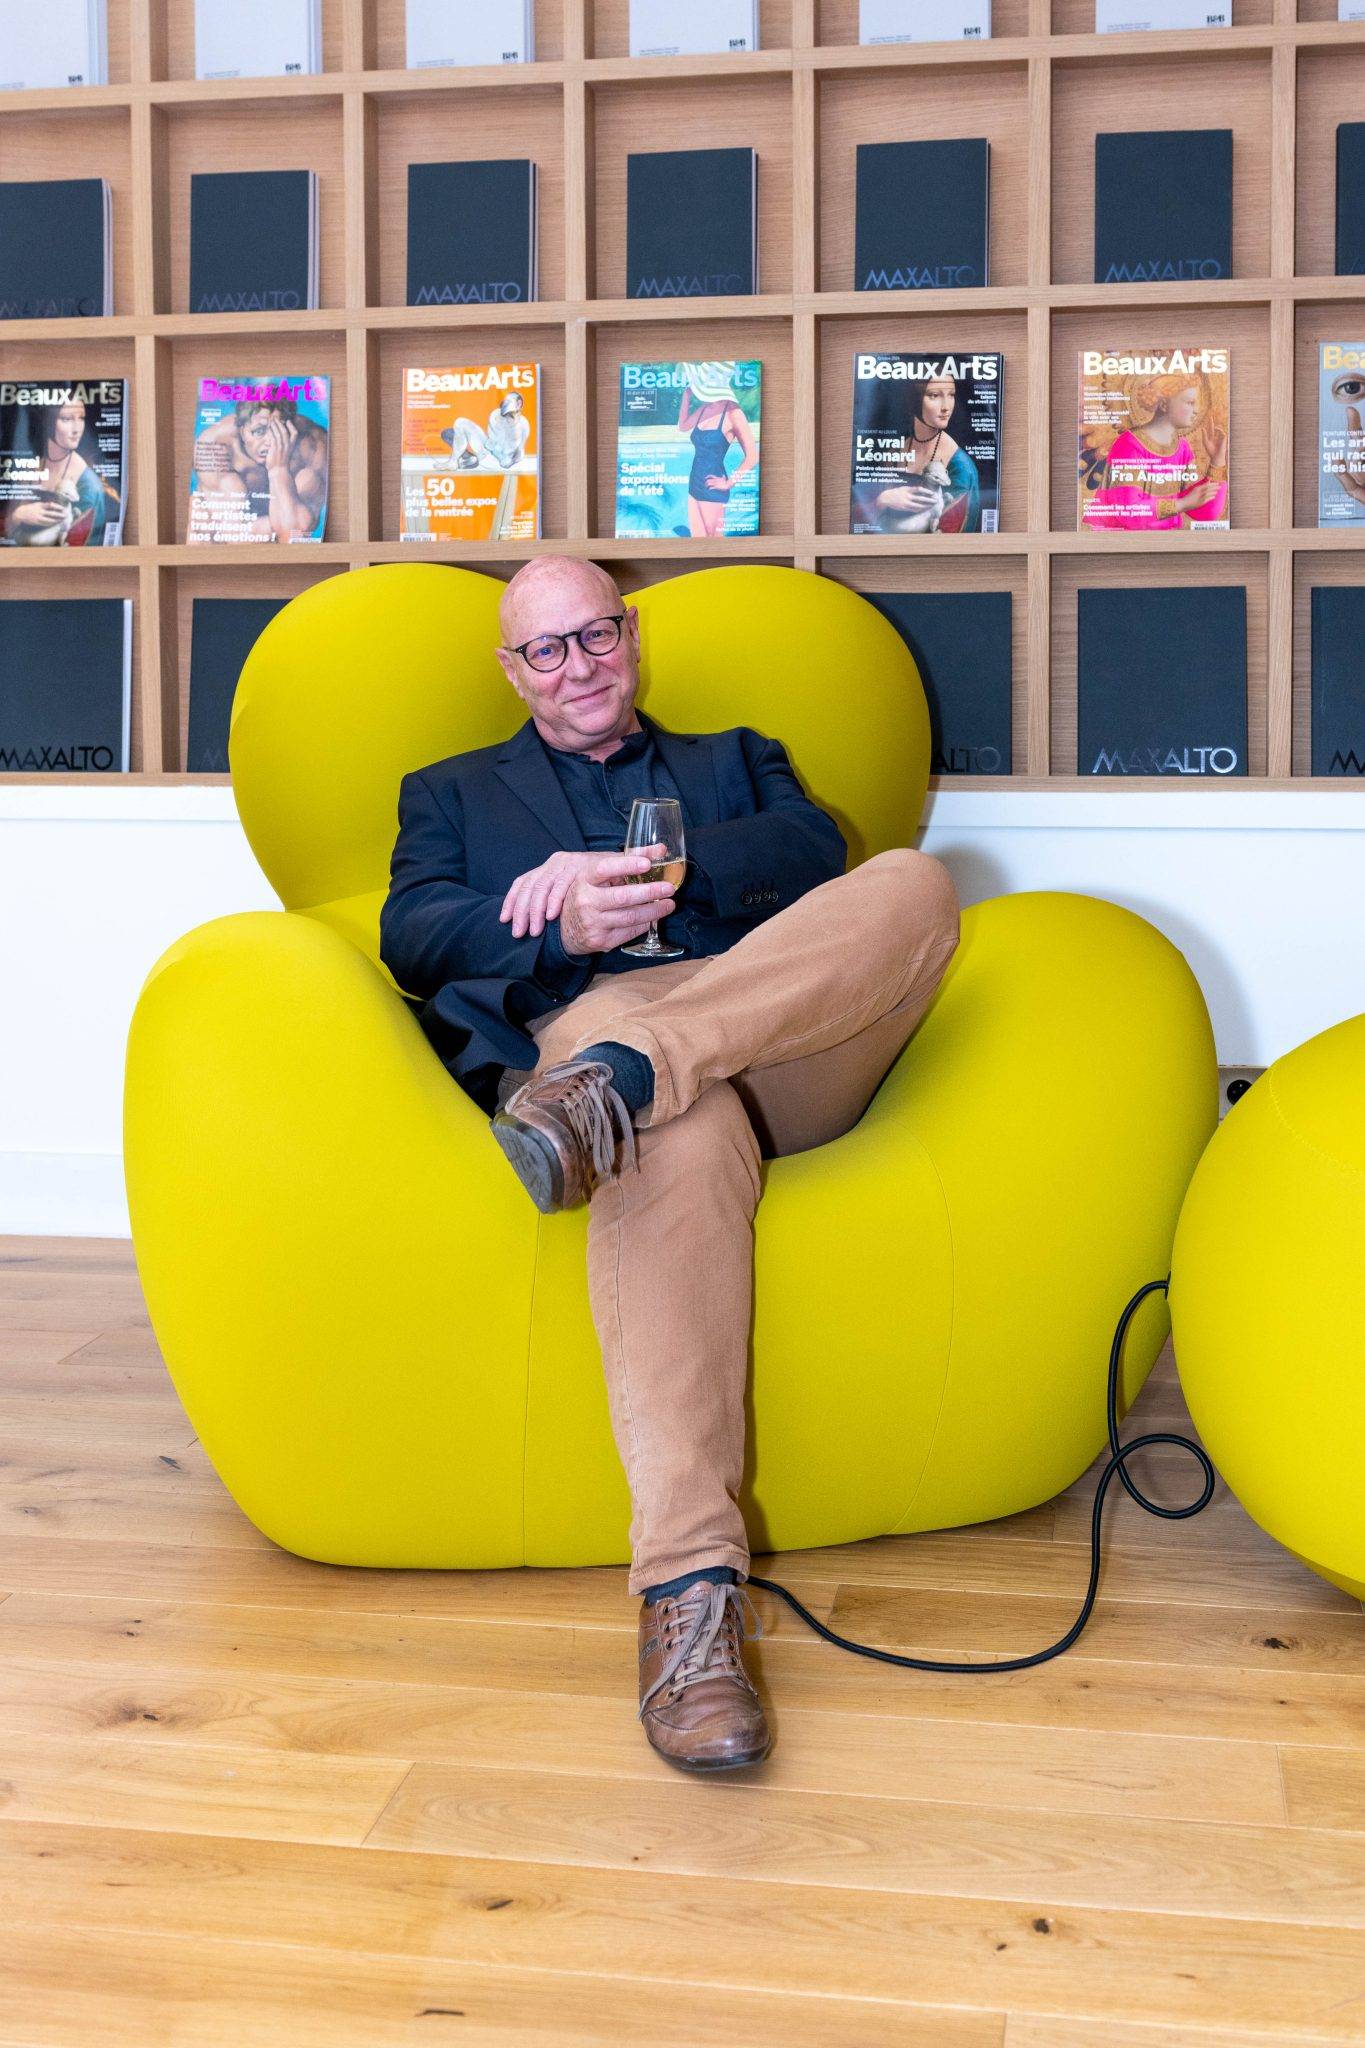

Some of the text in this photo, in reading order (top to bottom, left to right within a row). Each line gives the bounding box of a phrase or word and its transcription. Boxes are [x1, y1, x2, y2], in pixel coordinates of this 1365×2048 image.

[864, 265, 976, 289] MAXALTO
[1105, 259, 1221, 283] MAXALTO
[636, 274, 744, 298] MAXALTO
[415, 282, 521, 304] MAXALTO
[199, 291, 300, 311] MAXALTO
[857, 355, 998, 380] BeauxArts
[1083, 349, 1228, 375] BeauxArts
[407, 366, 534, 392] BeauxArts
[0, 382, 122, 406] BeauxArts
[201, 378, 327, 401] BeauxArts
[857, 435, 905, 448] Le vrai
[1323, 437, 1345, 448] Les
[856, 448, 916, 462] Léonard
[1323, 450, 1344, 463] qui
[15, 456, 41, 468] vrai
[1323, 461, 1346, 473] des
[0, 468, 49, 481] éonard
[621, 463, 665, 475] Spécial
[620, 474, 689, 486] expositions
[1111, 470, 1199, 484] Fra Angelico
[405, 478, 455, 497] Les 50
[620, 486, 634, 496] de
[192, 498, 251, 510] Comment
[405, 497, 497, 508] plus belles expos
[191, 510, 257, 520] les artistes
[405, 507, 473, 517] de la rentrée
[190, 520, 253, 531] traduisent
[189, 533, 211, 541] nos
[213, 531, 270, 541] émotions
[0, 746, 113, 771] MAXALTO
[1093, 747, 1237, 774] MAXALTO
